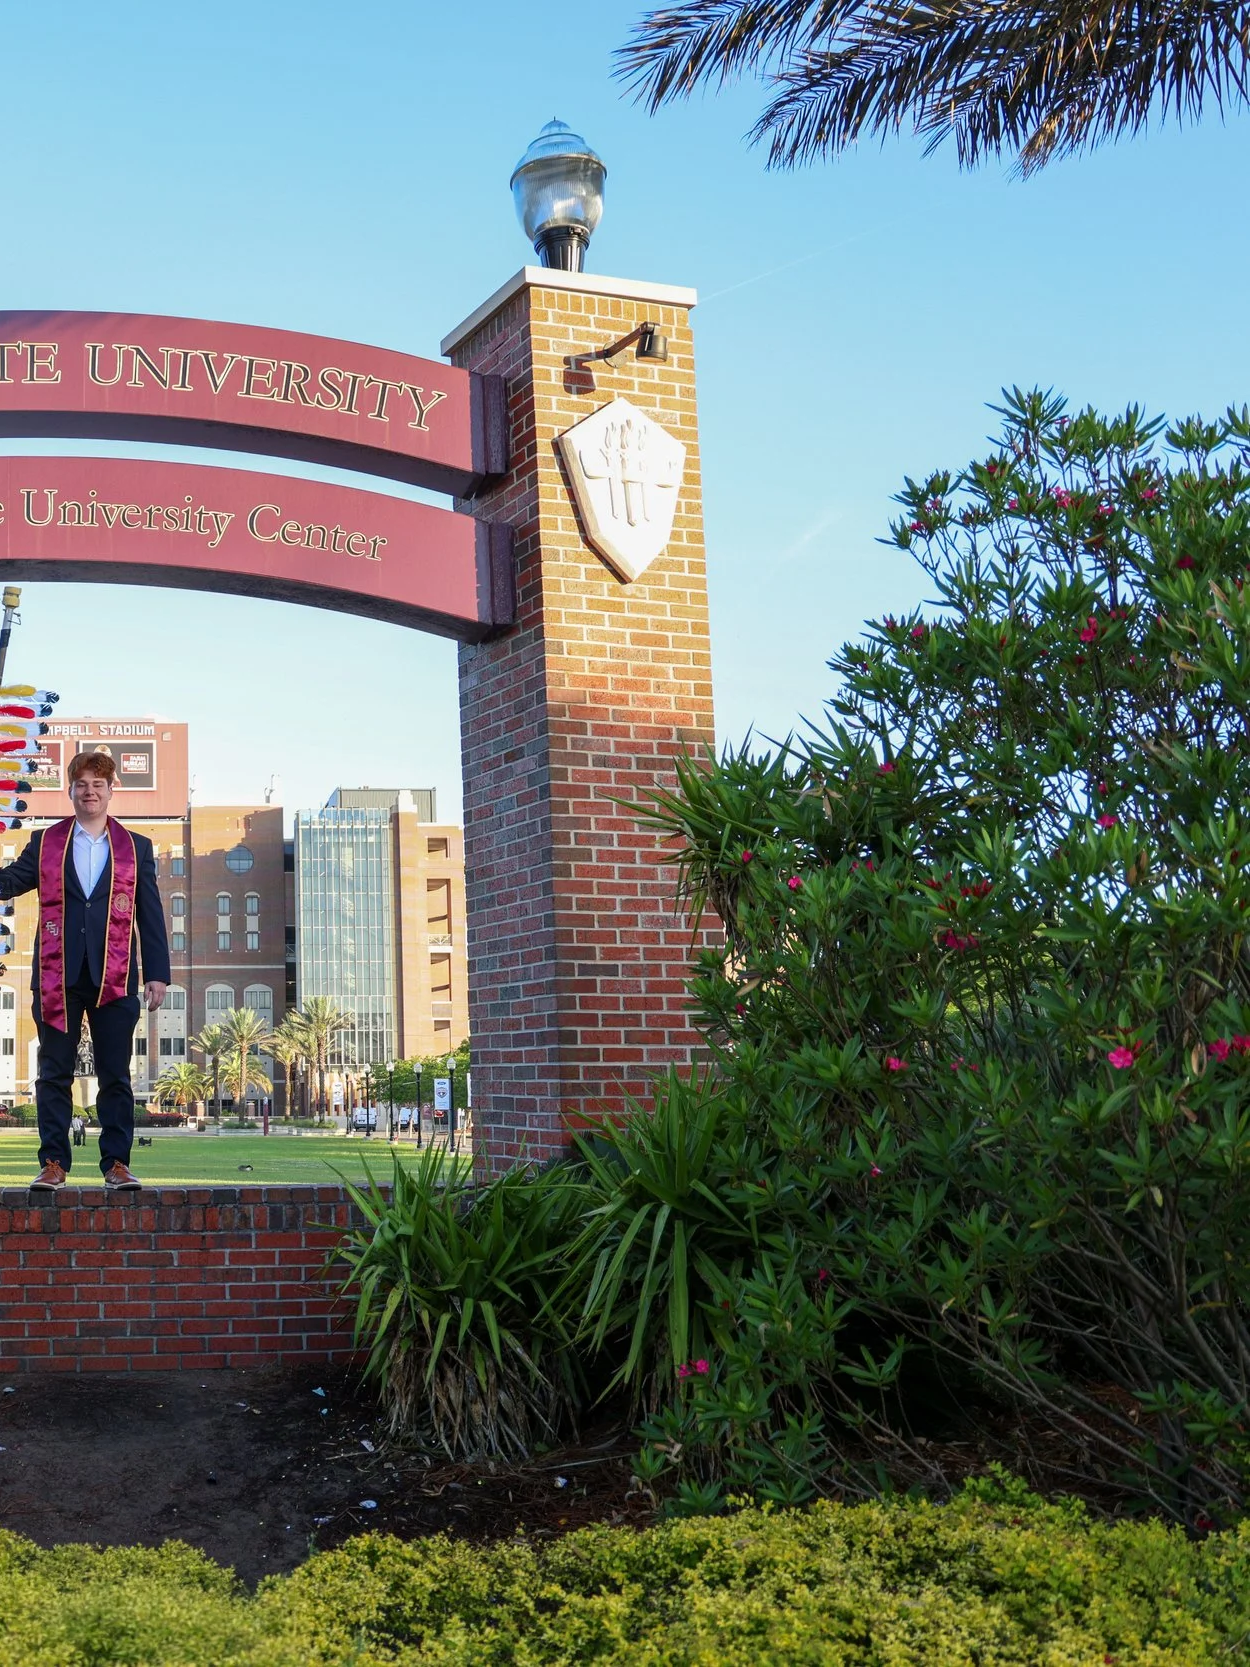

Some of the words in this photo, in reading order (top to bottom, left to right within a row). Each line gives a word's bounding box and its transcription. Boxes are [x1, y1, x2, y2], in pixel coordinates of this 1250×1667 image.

[84, 343, 448, 432] UNIVERSITY
[20, 488, 235, 547] University
[246, 503, 388, 561] Center
[44, 725, 93, 736] MPBELL
[98, 724, 155, 736] STADIUM
